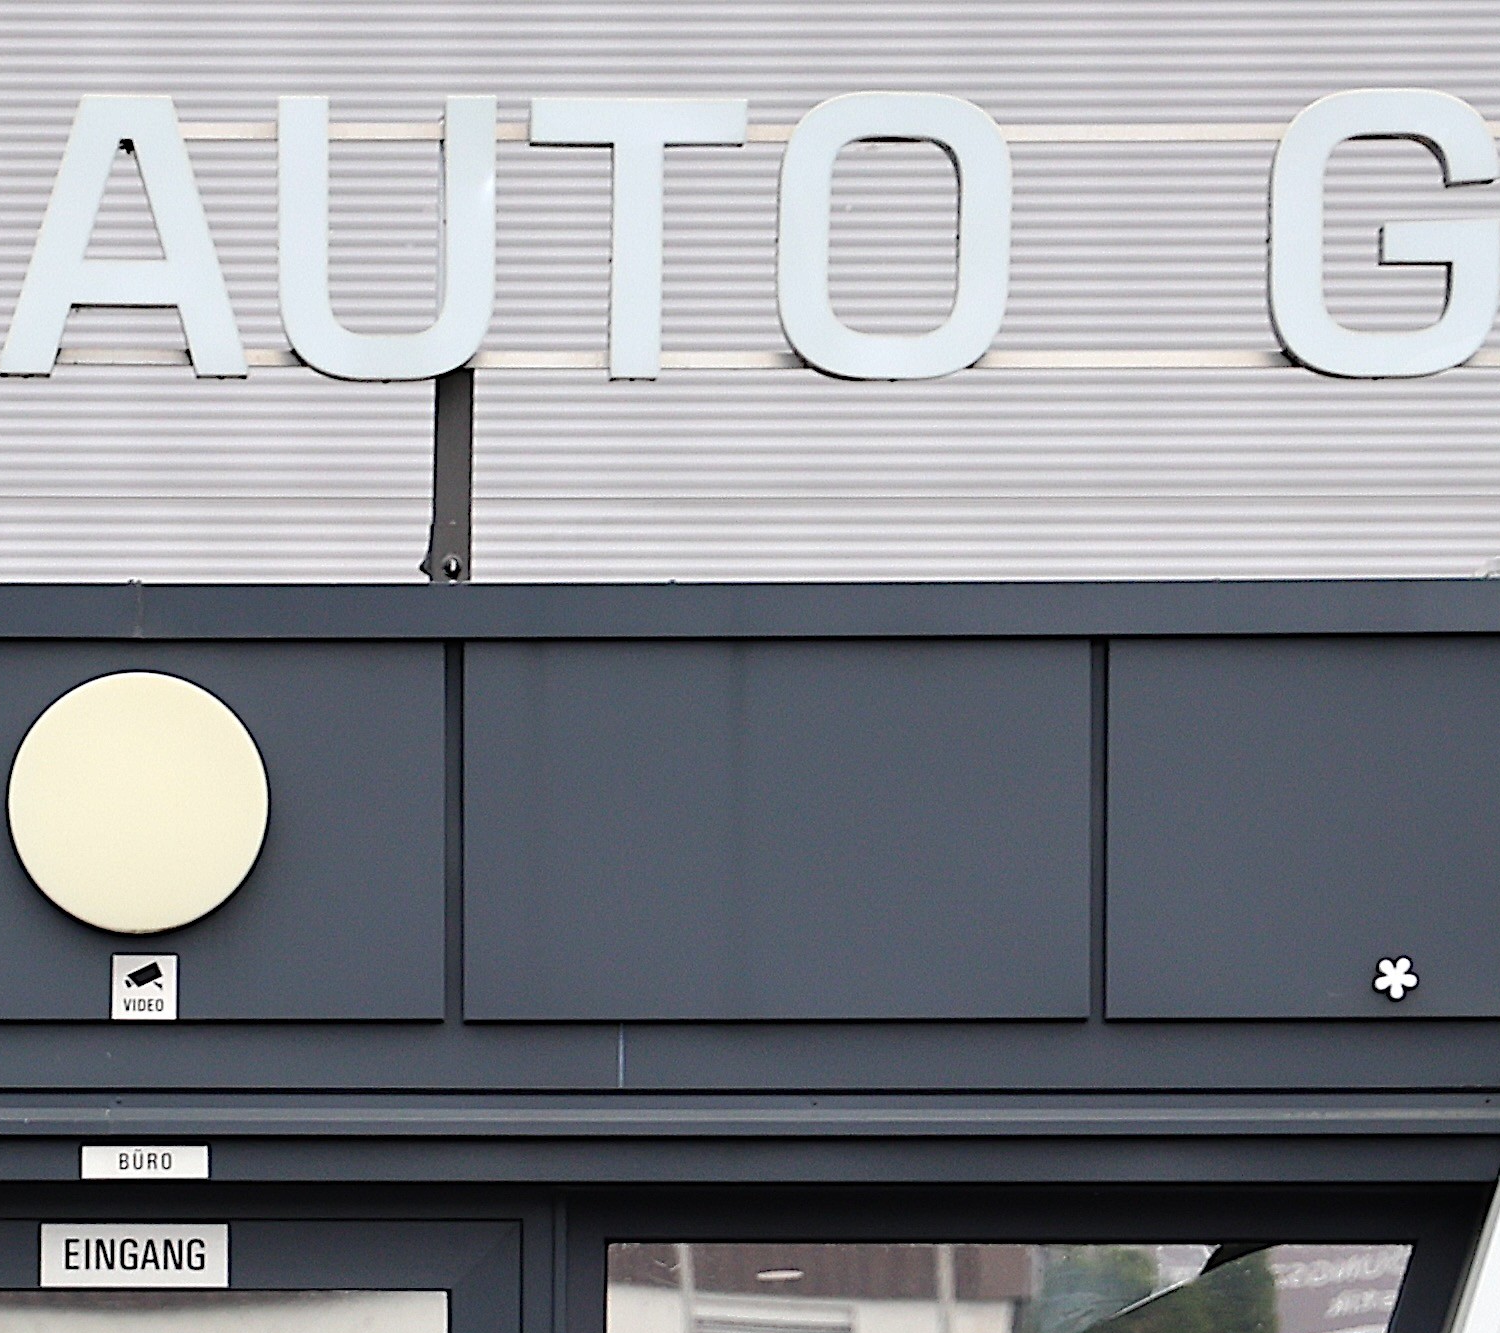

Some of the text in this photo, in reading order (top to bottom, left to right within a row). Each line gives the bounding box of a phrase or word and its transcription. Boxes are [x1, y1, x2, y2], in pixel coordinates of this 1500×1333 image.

[1, 88, 1015, 384] AUTO
[123, 997, 165, 1013] VIDEO
[118, 1149, 173, 1171] BÜRO
[63, 1238, 207, 1271] EINGANG
